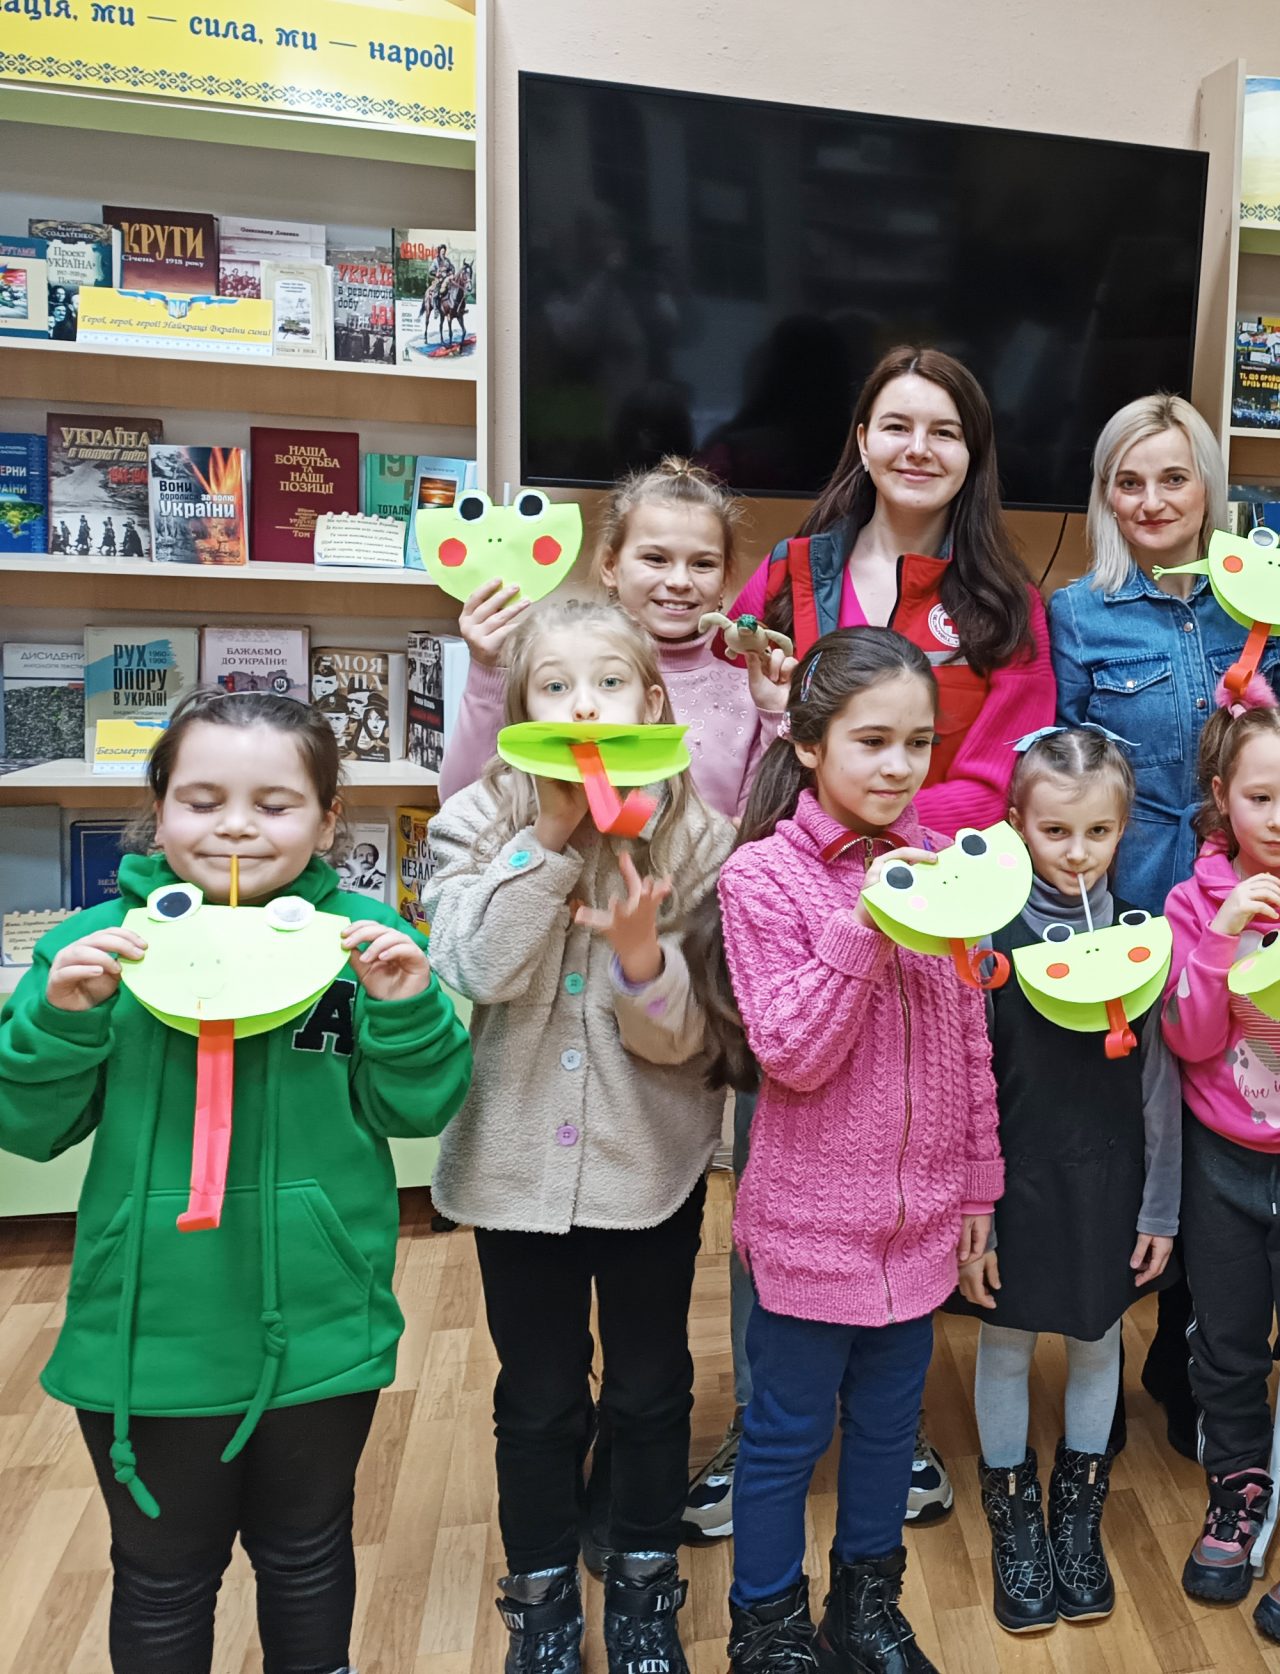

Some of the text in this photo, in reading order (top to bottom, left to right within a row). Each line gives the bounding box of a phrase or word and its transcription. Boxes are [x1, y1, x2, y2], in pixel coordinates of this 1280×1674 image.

[0, 0, 78, 21] ація,
[91, 3, 135, 26] ми
[189, 16, 263, 44] сила,
[276, 28, 317, 50] ми
[369, 41, 454, 71] народ!
[121, 222, 205, 261] КРУТИ
[60, 426, 150, 449] УКРАЇНА
[288, 445, 328, 458] НАША
[274, 453, 341, 469] БОРОТЬБА
[290, 472, 325, 484] НАШІ
[159, 480, 192, 493] Вони
[279, 481, 335, 495] ПОЗИЦІЇ
[159, 500, 236, 519] України
[378, 503, 410, 516] ТОТАЛЬ
[113, 643, 148, 668] РУХ
[226, 647, 282, 657] БАЖАЄМО
[221, 656, 288, 667] ДО УКРАЇНИ!
[113, 668, 168, 691] ОПОРУ
[113, 691, 168, 707] В УКРАЇНІ
[1238, 1074, 1270, 1099] love
